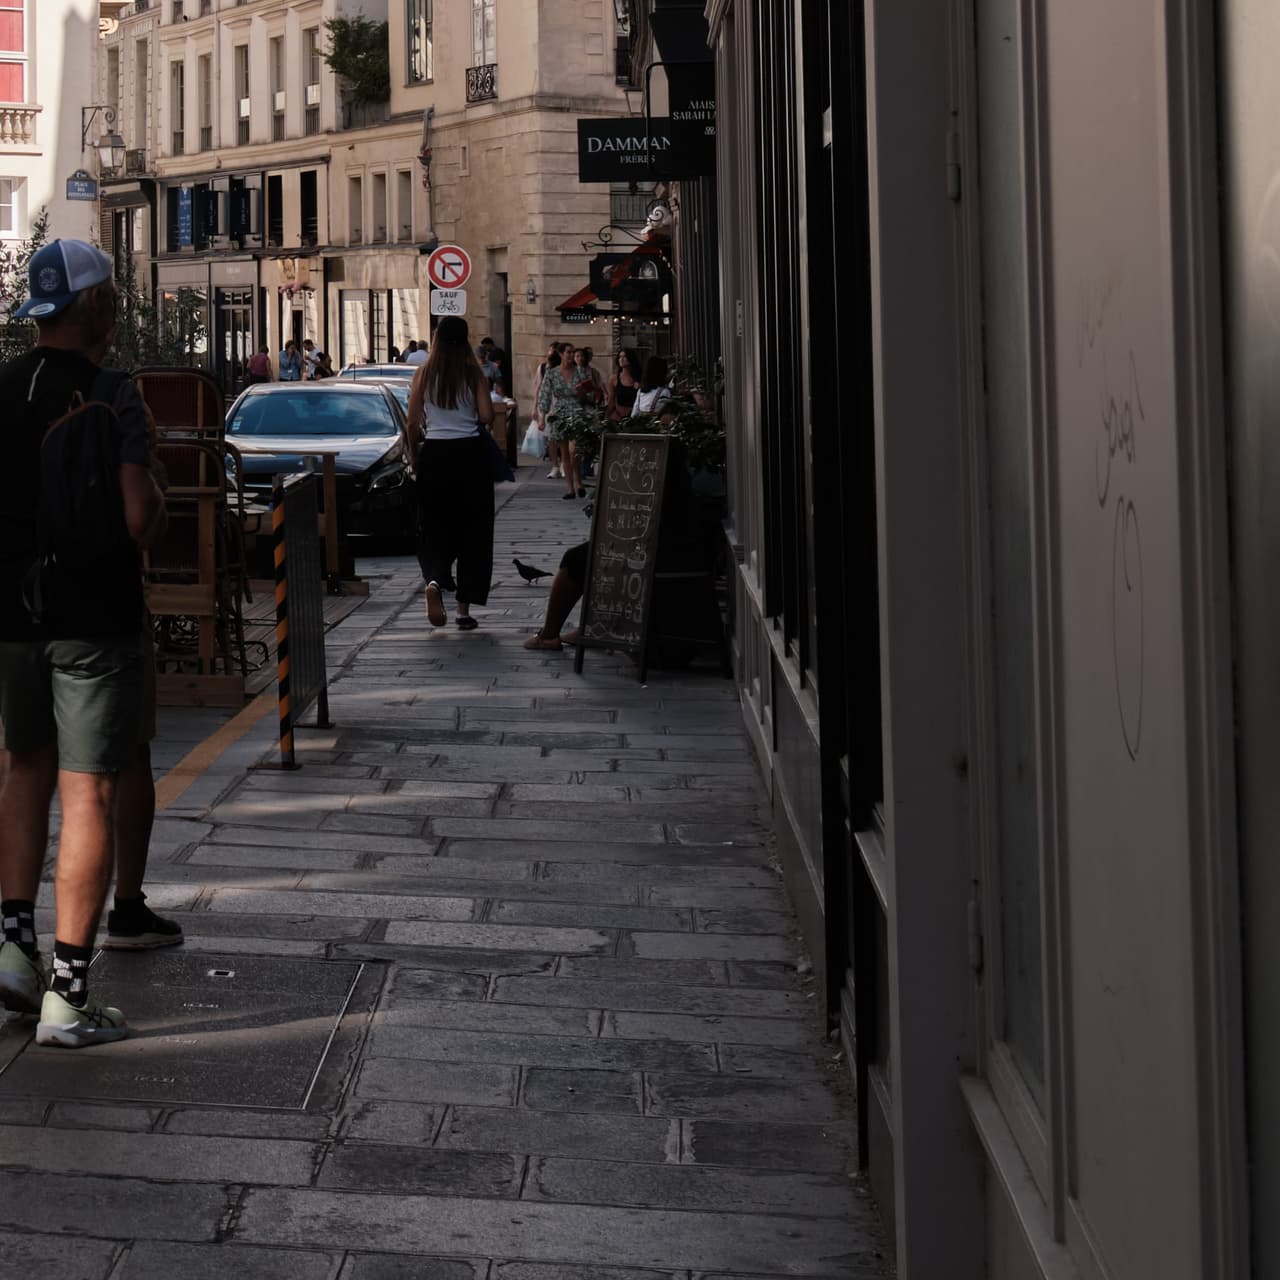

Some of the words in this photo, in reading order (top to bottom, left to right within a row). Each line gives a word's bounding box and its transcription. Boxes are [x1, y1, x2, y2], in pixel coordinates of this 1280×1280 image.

[688, 101, 715, 110] MAIS
[673, 111, 704, 120] SARAH
[587, 137, 671, 153] DAMMAN
